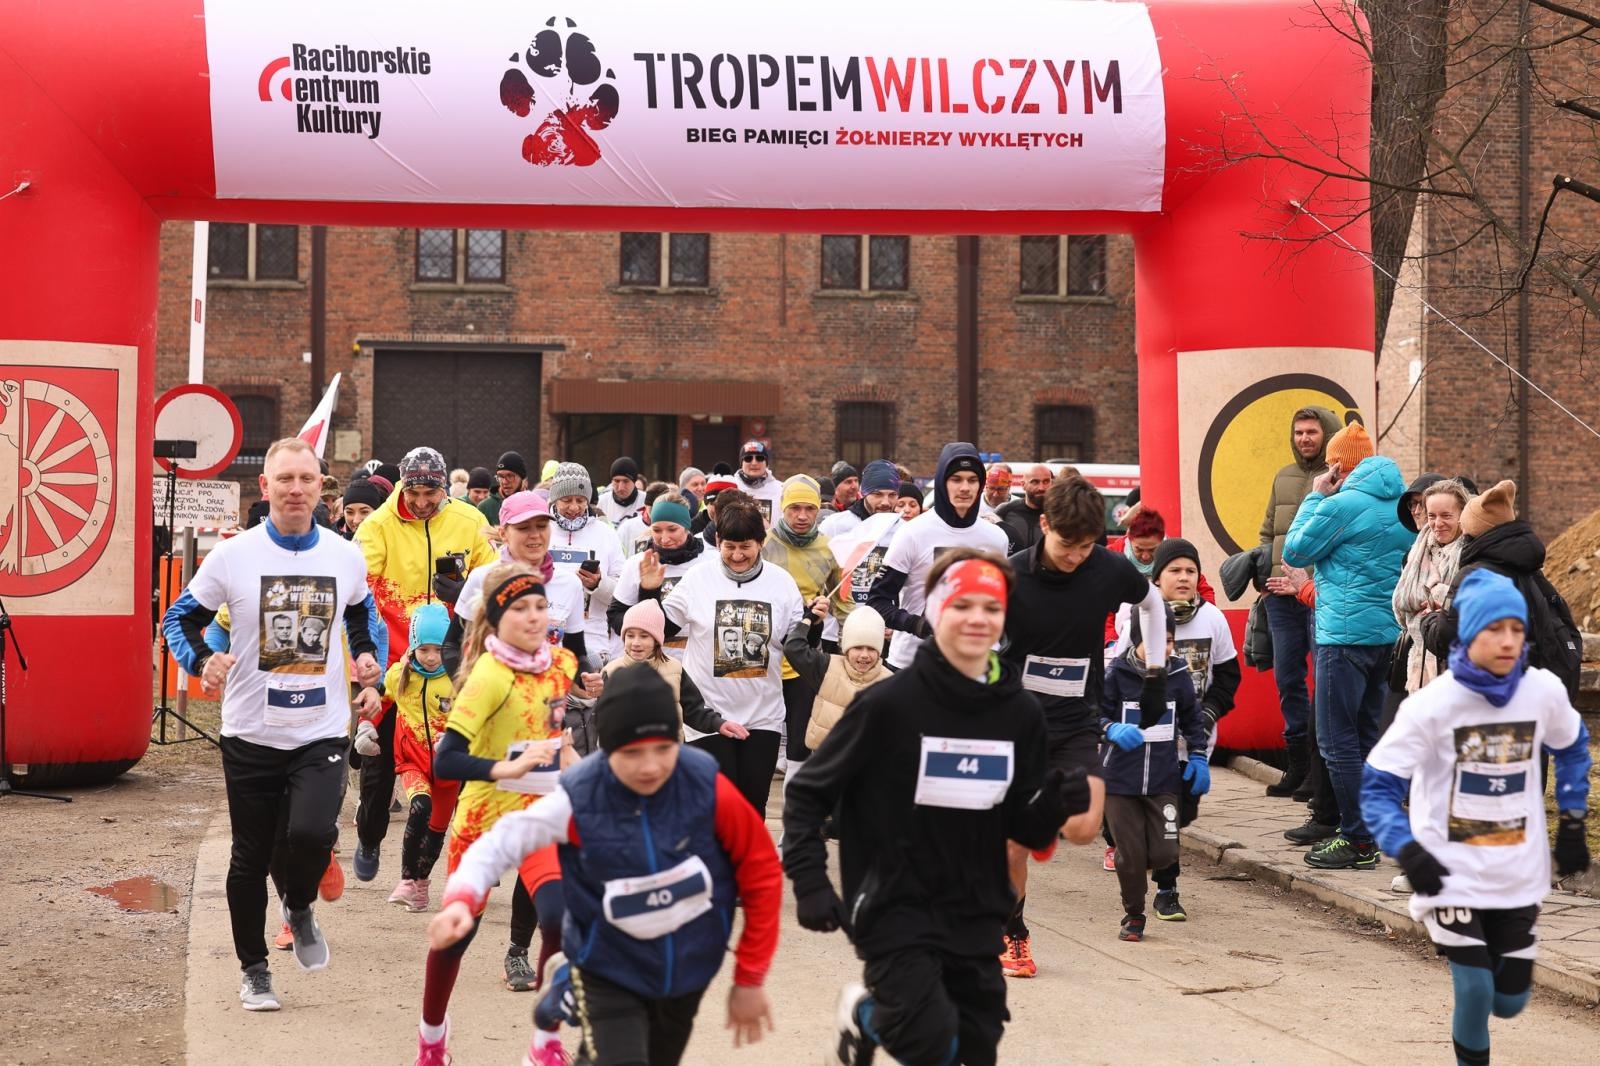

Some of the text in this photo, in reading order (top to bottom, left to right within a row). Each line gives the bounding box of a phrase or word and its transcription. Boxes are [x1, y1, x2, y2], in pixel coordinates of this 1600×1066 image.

[292, 43, 431, 75] Raciborskie
[295, 74, 380, 104] entrum
[296, 103, 382, 139] Kultury
[686, 126, 1084, 151] BIEG PAMIĘCI ŻOŁNIERZY WYKLĘTYCH
[197, 482, 232, 490] POJAZDÓW
[561, 552, 572, 561] 20
[1048, 667, 1064, 677] 47
[289, 693, 306, 704] 39
[956, 756, 979, 775] 44
[1487, 778, 1507, 793] 75
[645, 889, 673, 907] 40
